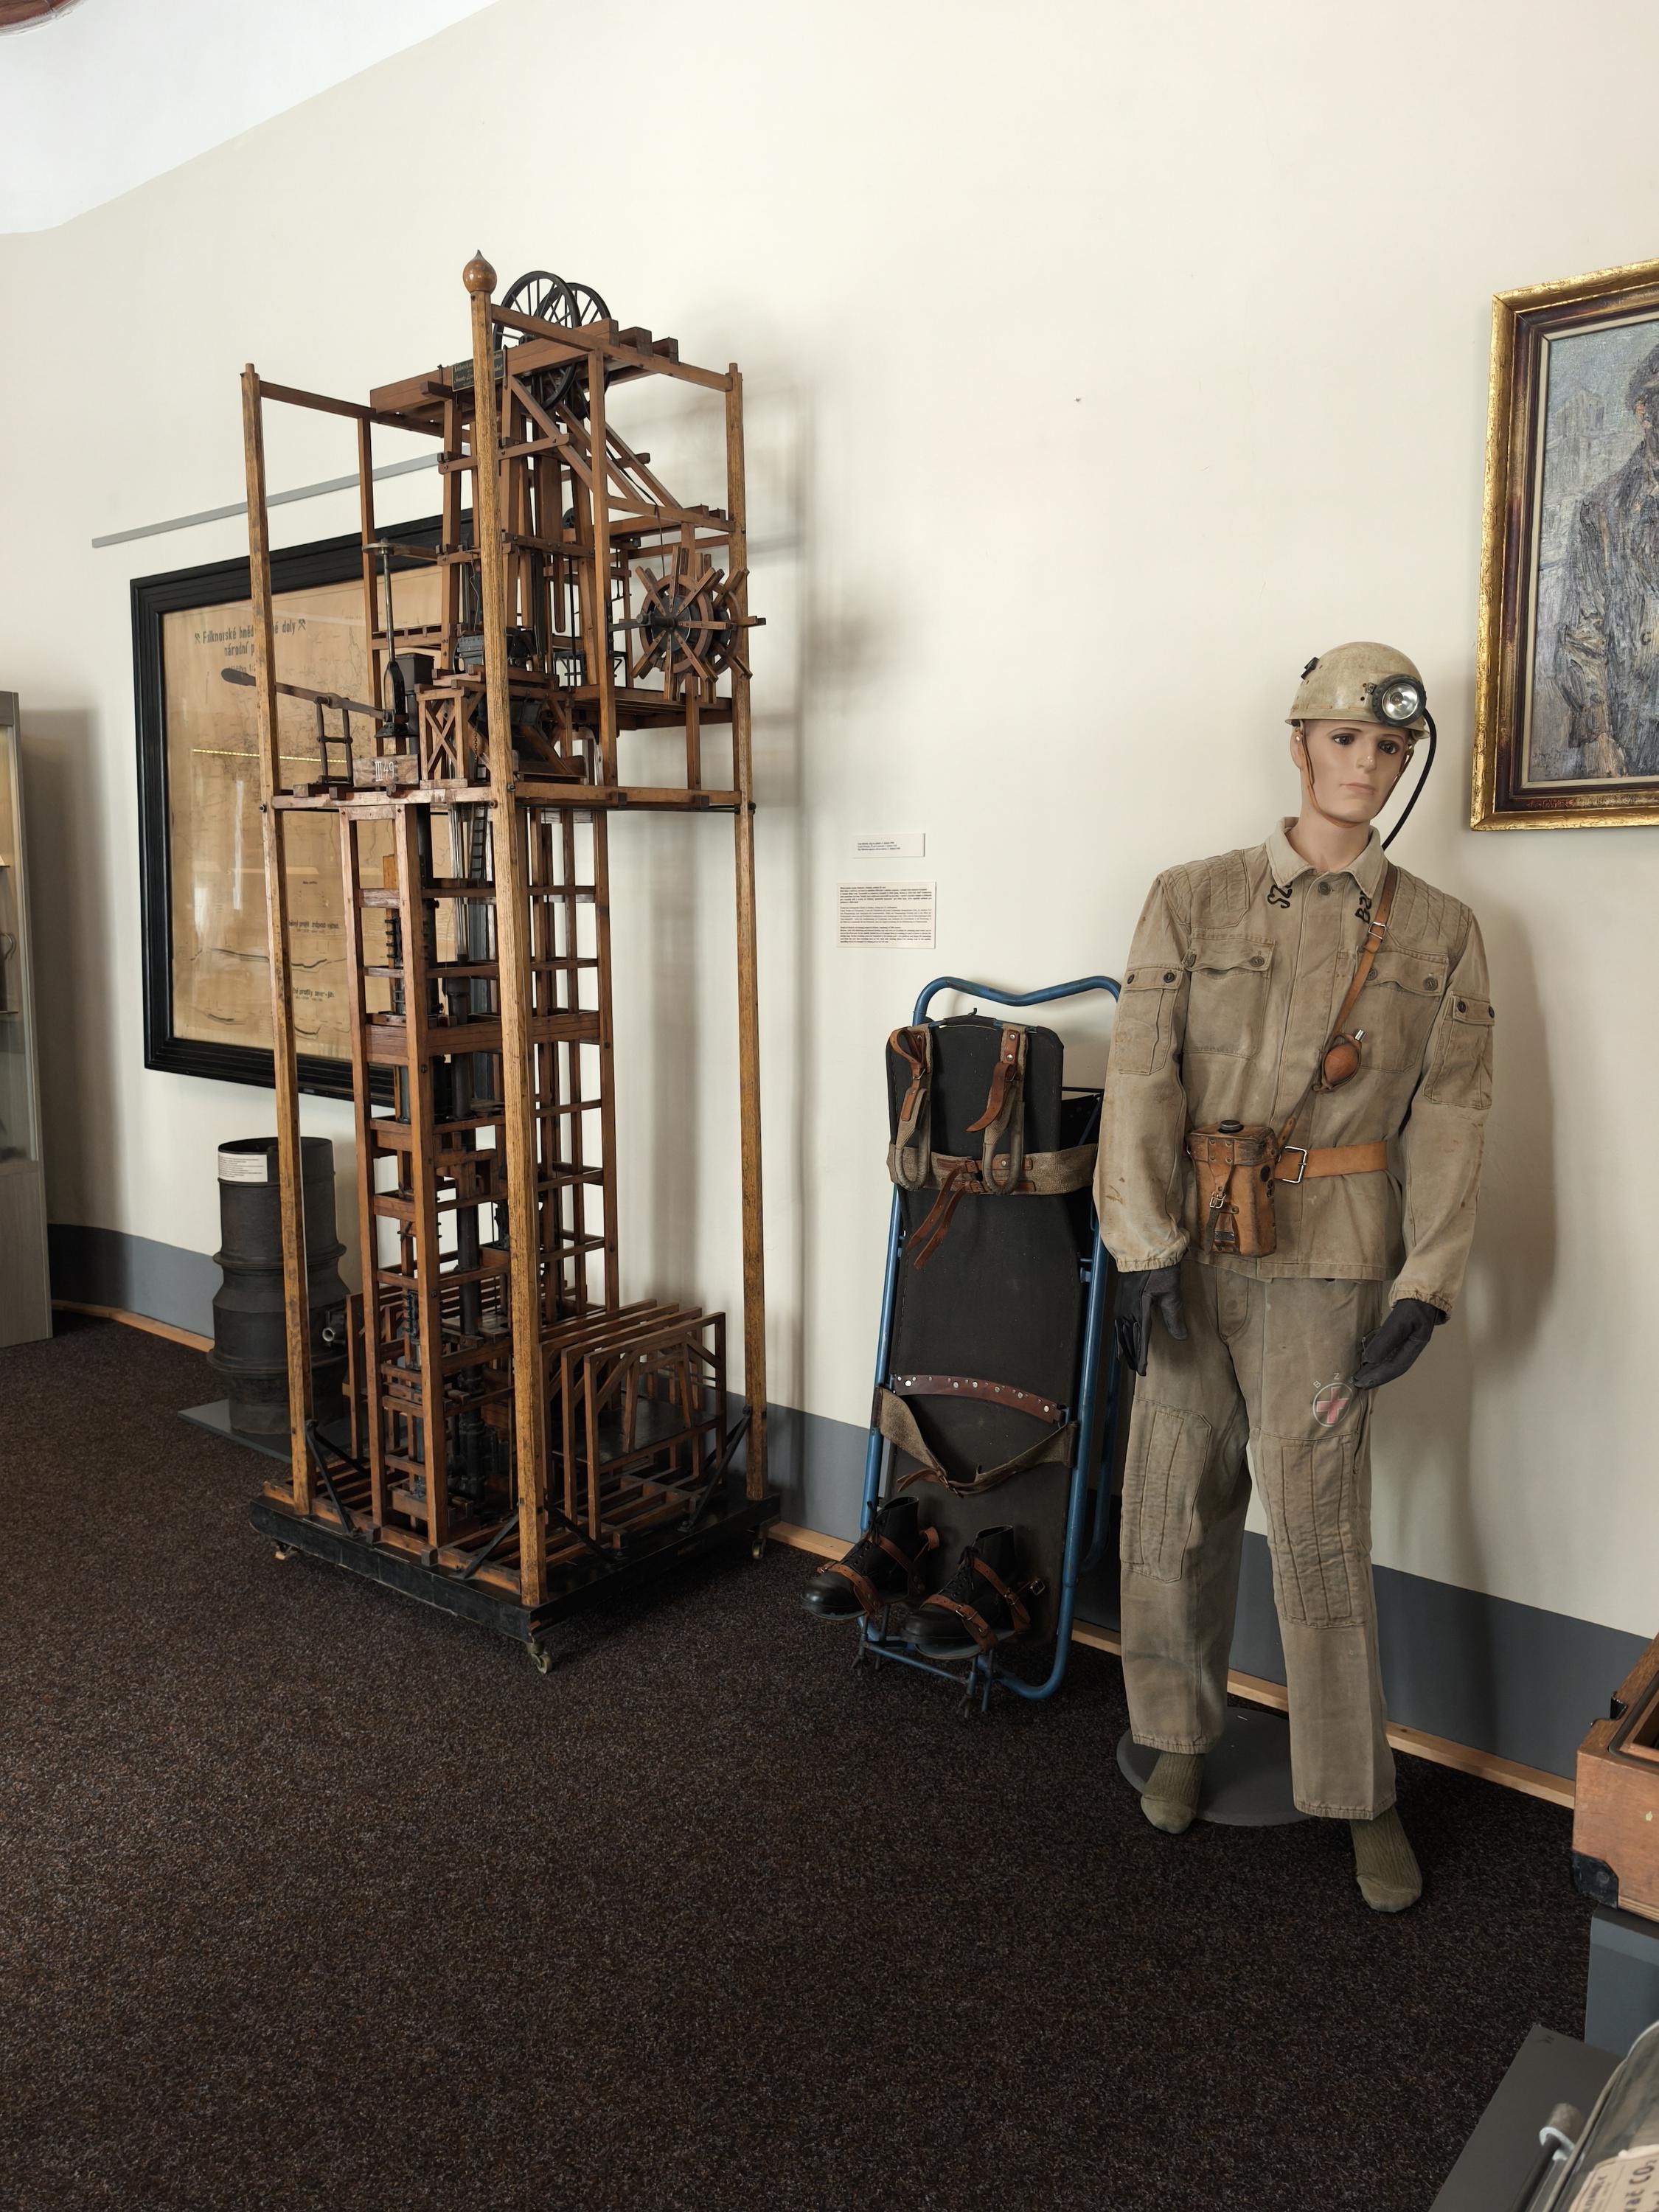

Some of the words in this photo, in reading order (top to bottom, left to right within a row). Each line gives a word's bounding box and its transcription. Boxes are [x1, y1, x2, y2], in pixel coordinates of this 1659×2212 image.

[282, 620, 296, 635] doly
[224, 641, 248, 656] národní
[383, 761, 394, 779] 49
[1354, 891, 1371, 924] BZ
